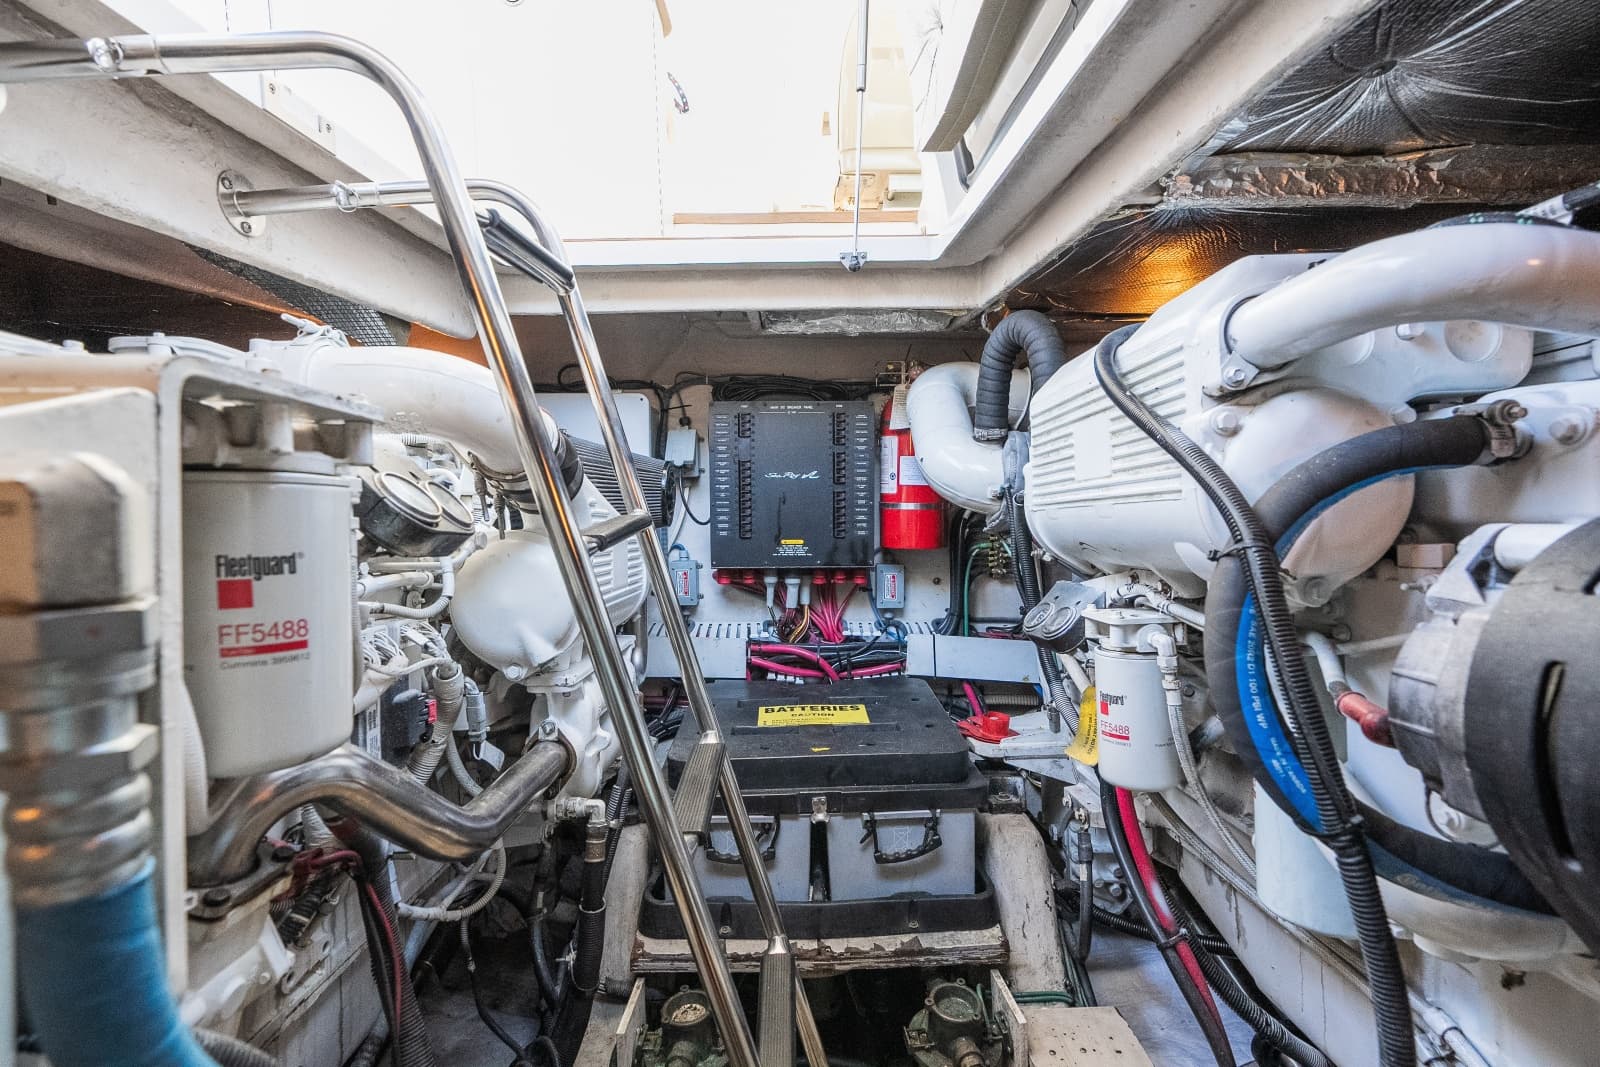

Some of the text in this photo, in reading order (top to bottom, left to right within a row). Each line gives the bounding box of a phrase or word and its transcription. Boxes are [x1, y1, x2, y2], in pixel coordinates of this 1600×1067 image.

[215, 552, 297, 581] Fleetguard
[218, 618, 309, 645] FF5488
[1249, 677, 1258, 695] 100
[764, 705, 861, 714] BATTERIES
[1101, 720, 1130, 736] FF5488
